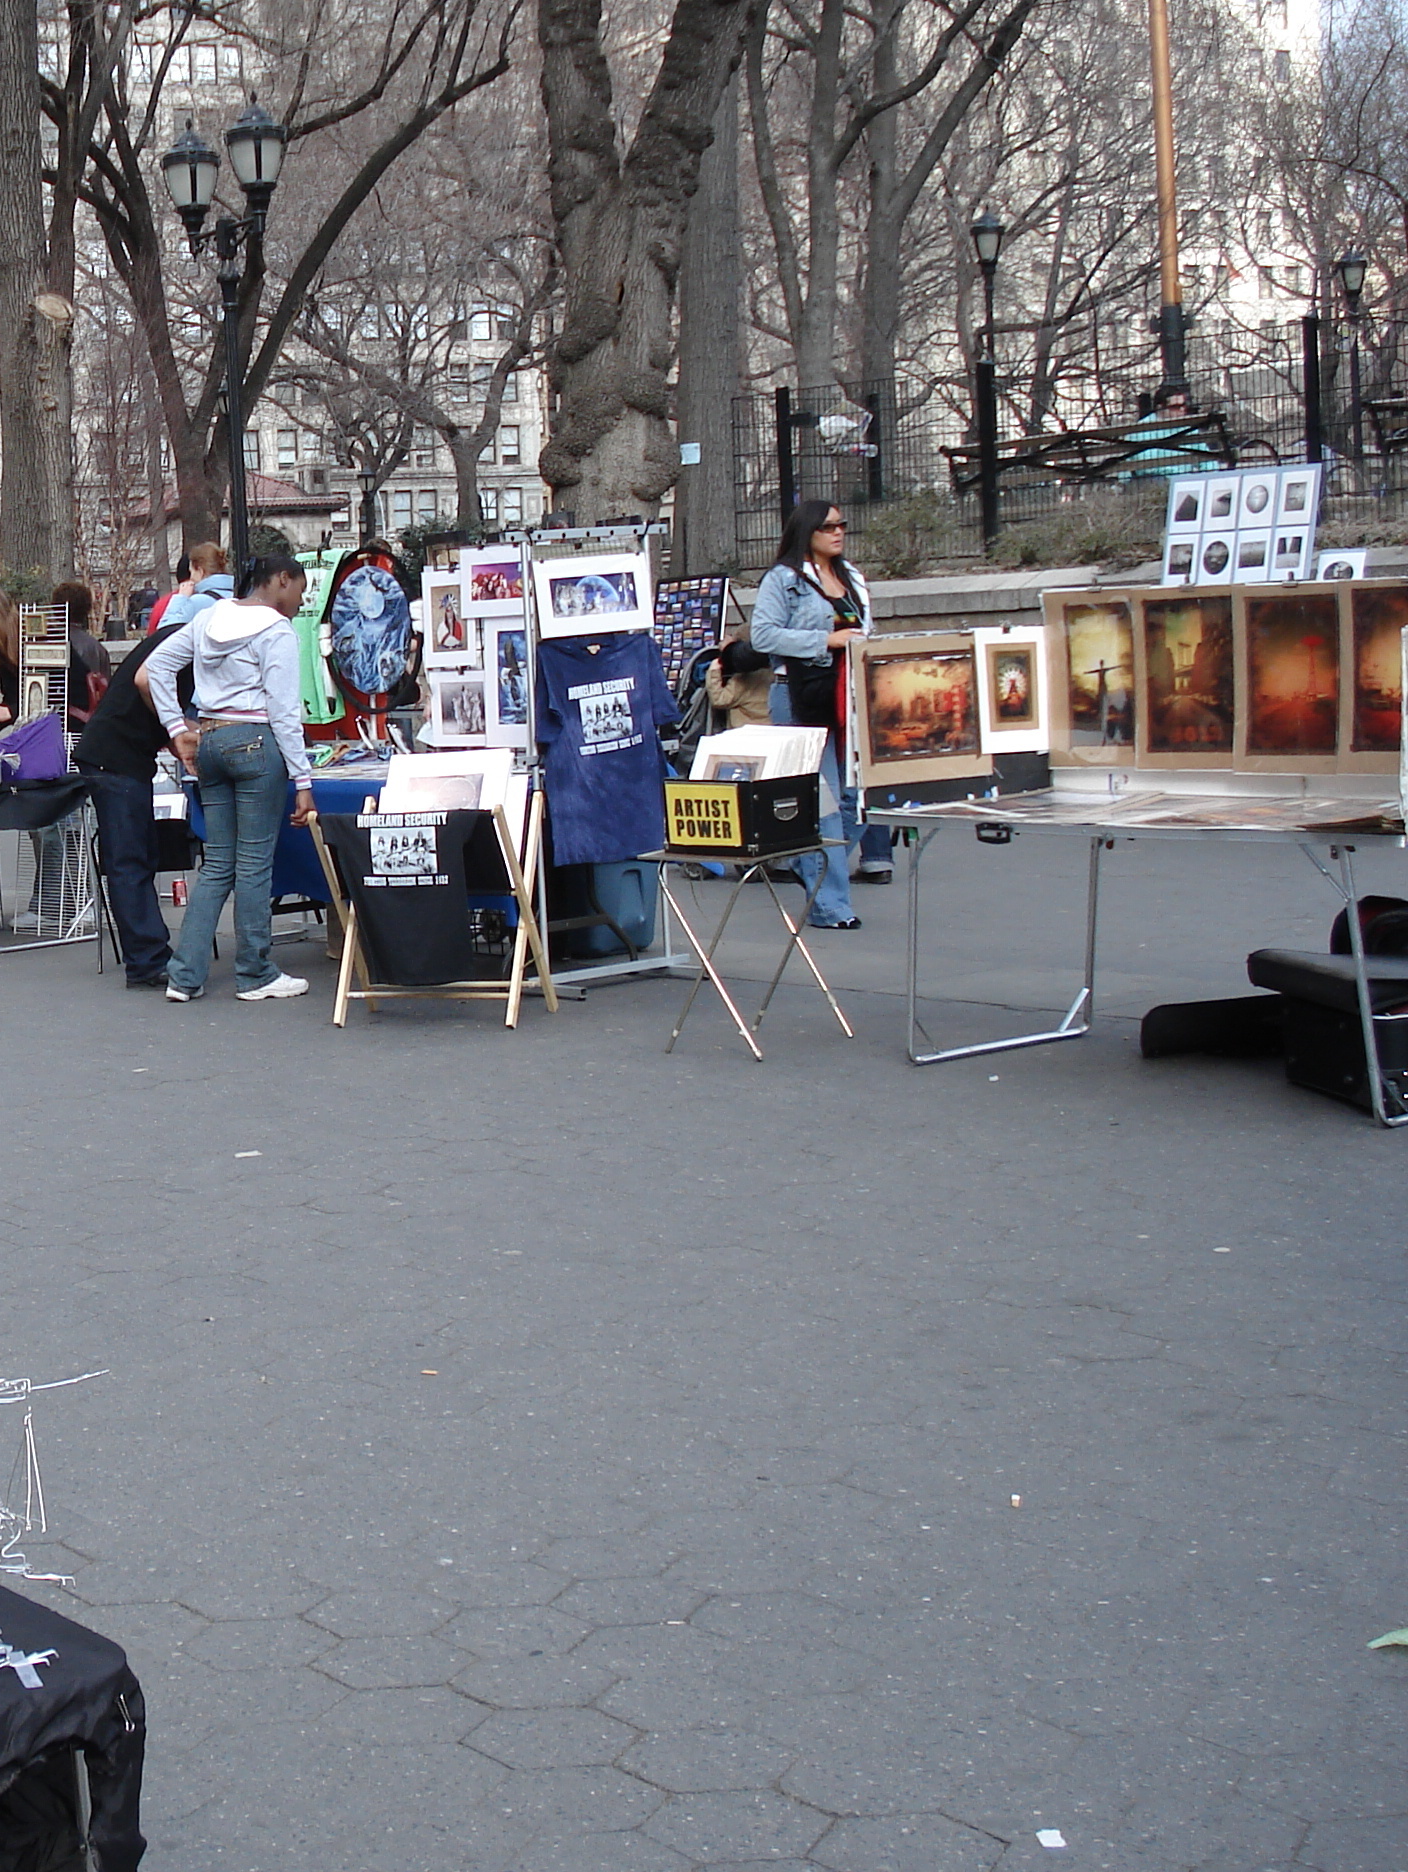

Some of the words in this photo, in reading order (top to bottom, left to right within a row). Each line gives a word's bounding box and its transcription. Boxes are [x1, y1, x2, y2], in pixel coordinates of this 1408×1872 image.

[602, 677, 635, 695] SECURITY
[674, 798, 730, 818] ARTIST
[357, 813, 404, 828] HOMELAND
[404, 811, 447, 827] SECURITY
[676, 819, 732, 839] POWER
